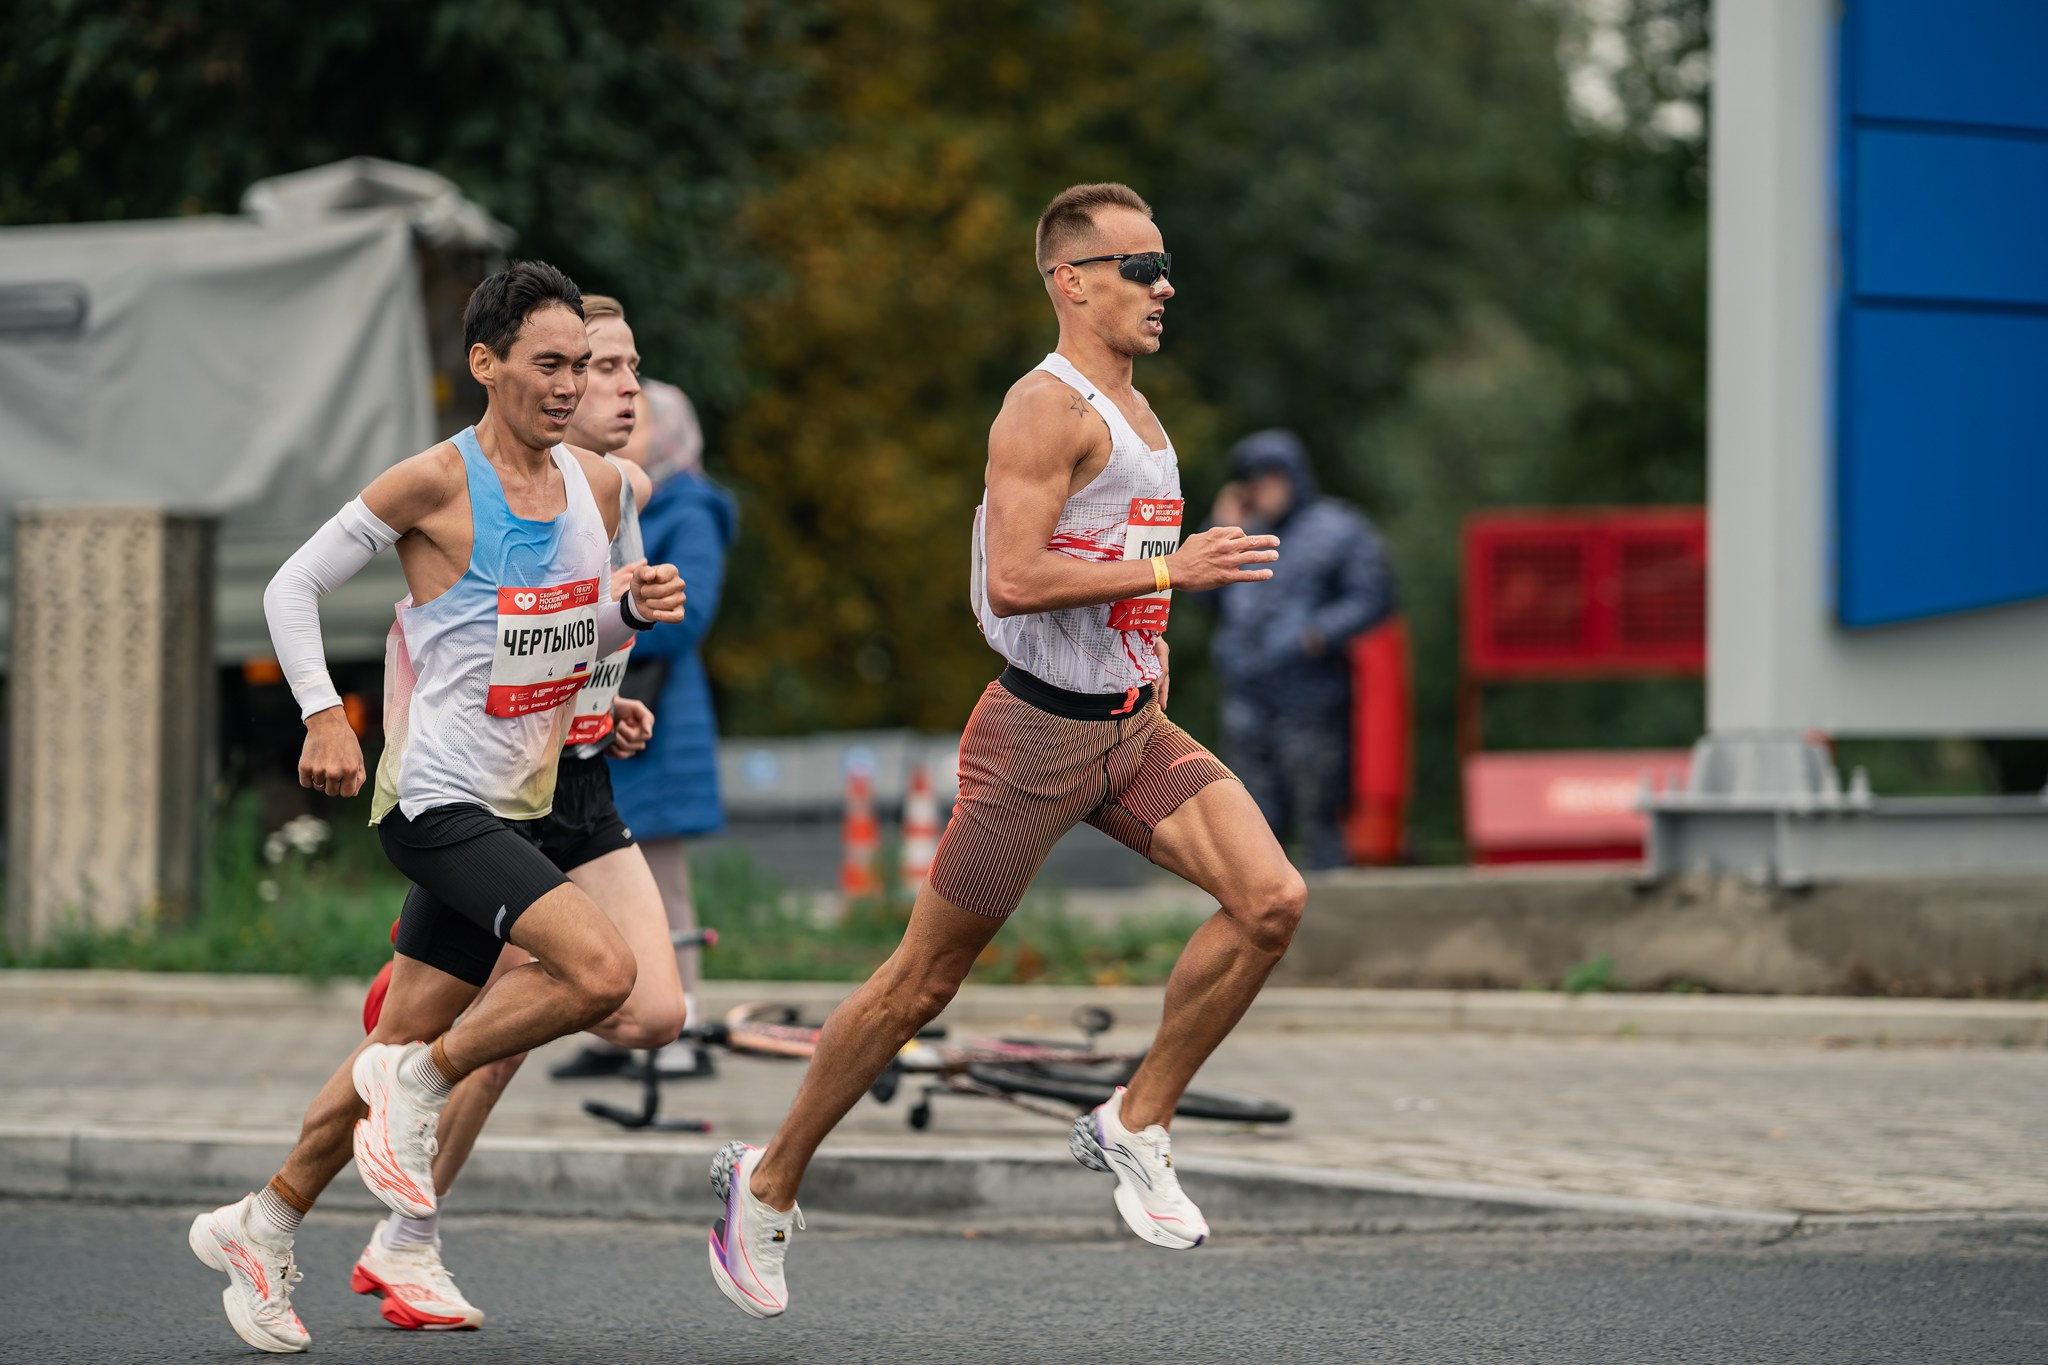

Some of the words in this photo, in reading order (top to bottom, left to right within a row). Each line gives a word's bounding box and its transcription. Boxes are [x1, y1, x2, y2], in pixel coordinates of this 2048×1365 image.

[539, 592, 570, 604] МОСКОВСКИЙ
[538, 601, 562, 611] МАРАФОН
[503, 618, 595, 656] ЧЕРТЫКОВ
[547, 667, 553, 677] 4
[592, 701, 598, 711] 6
